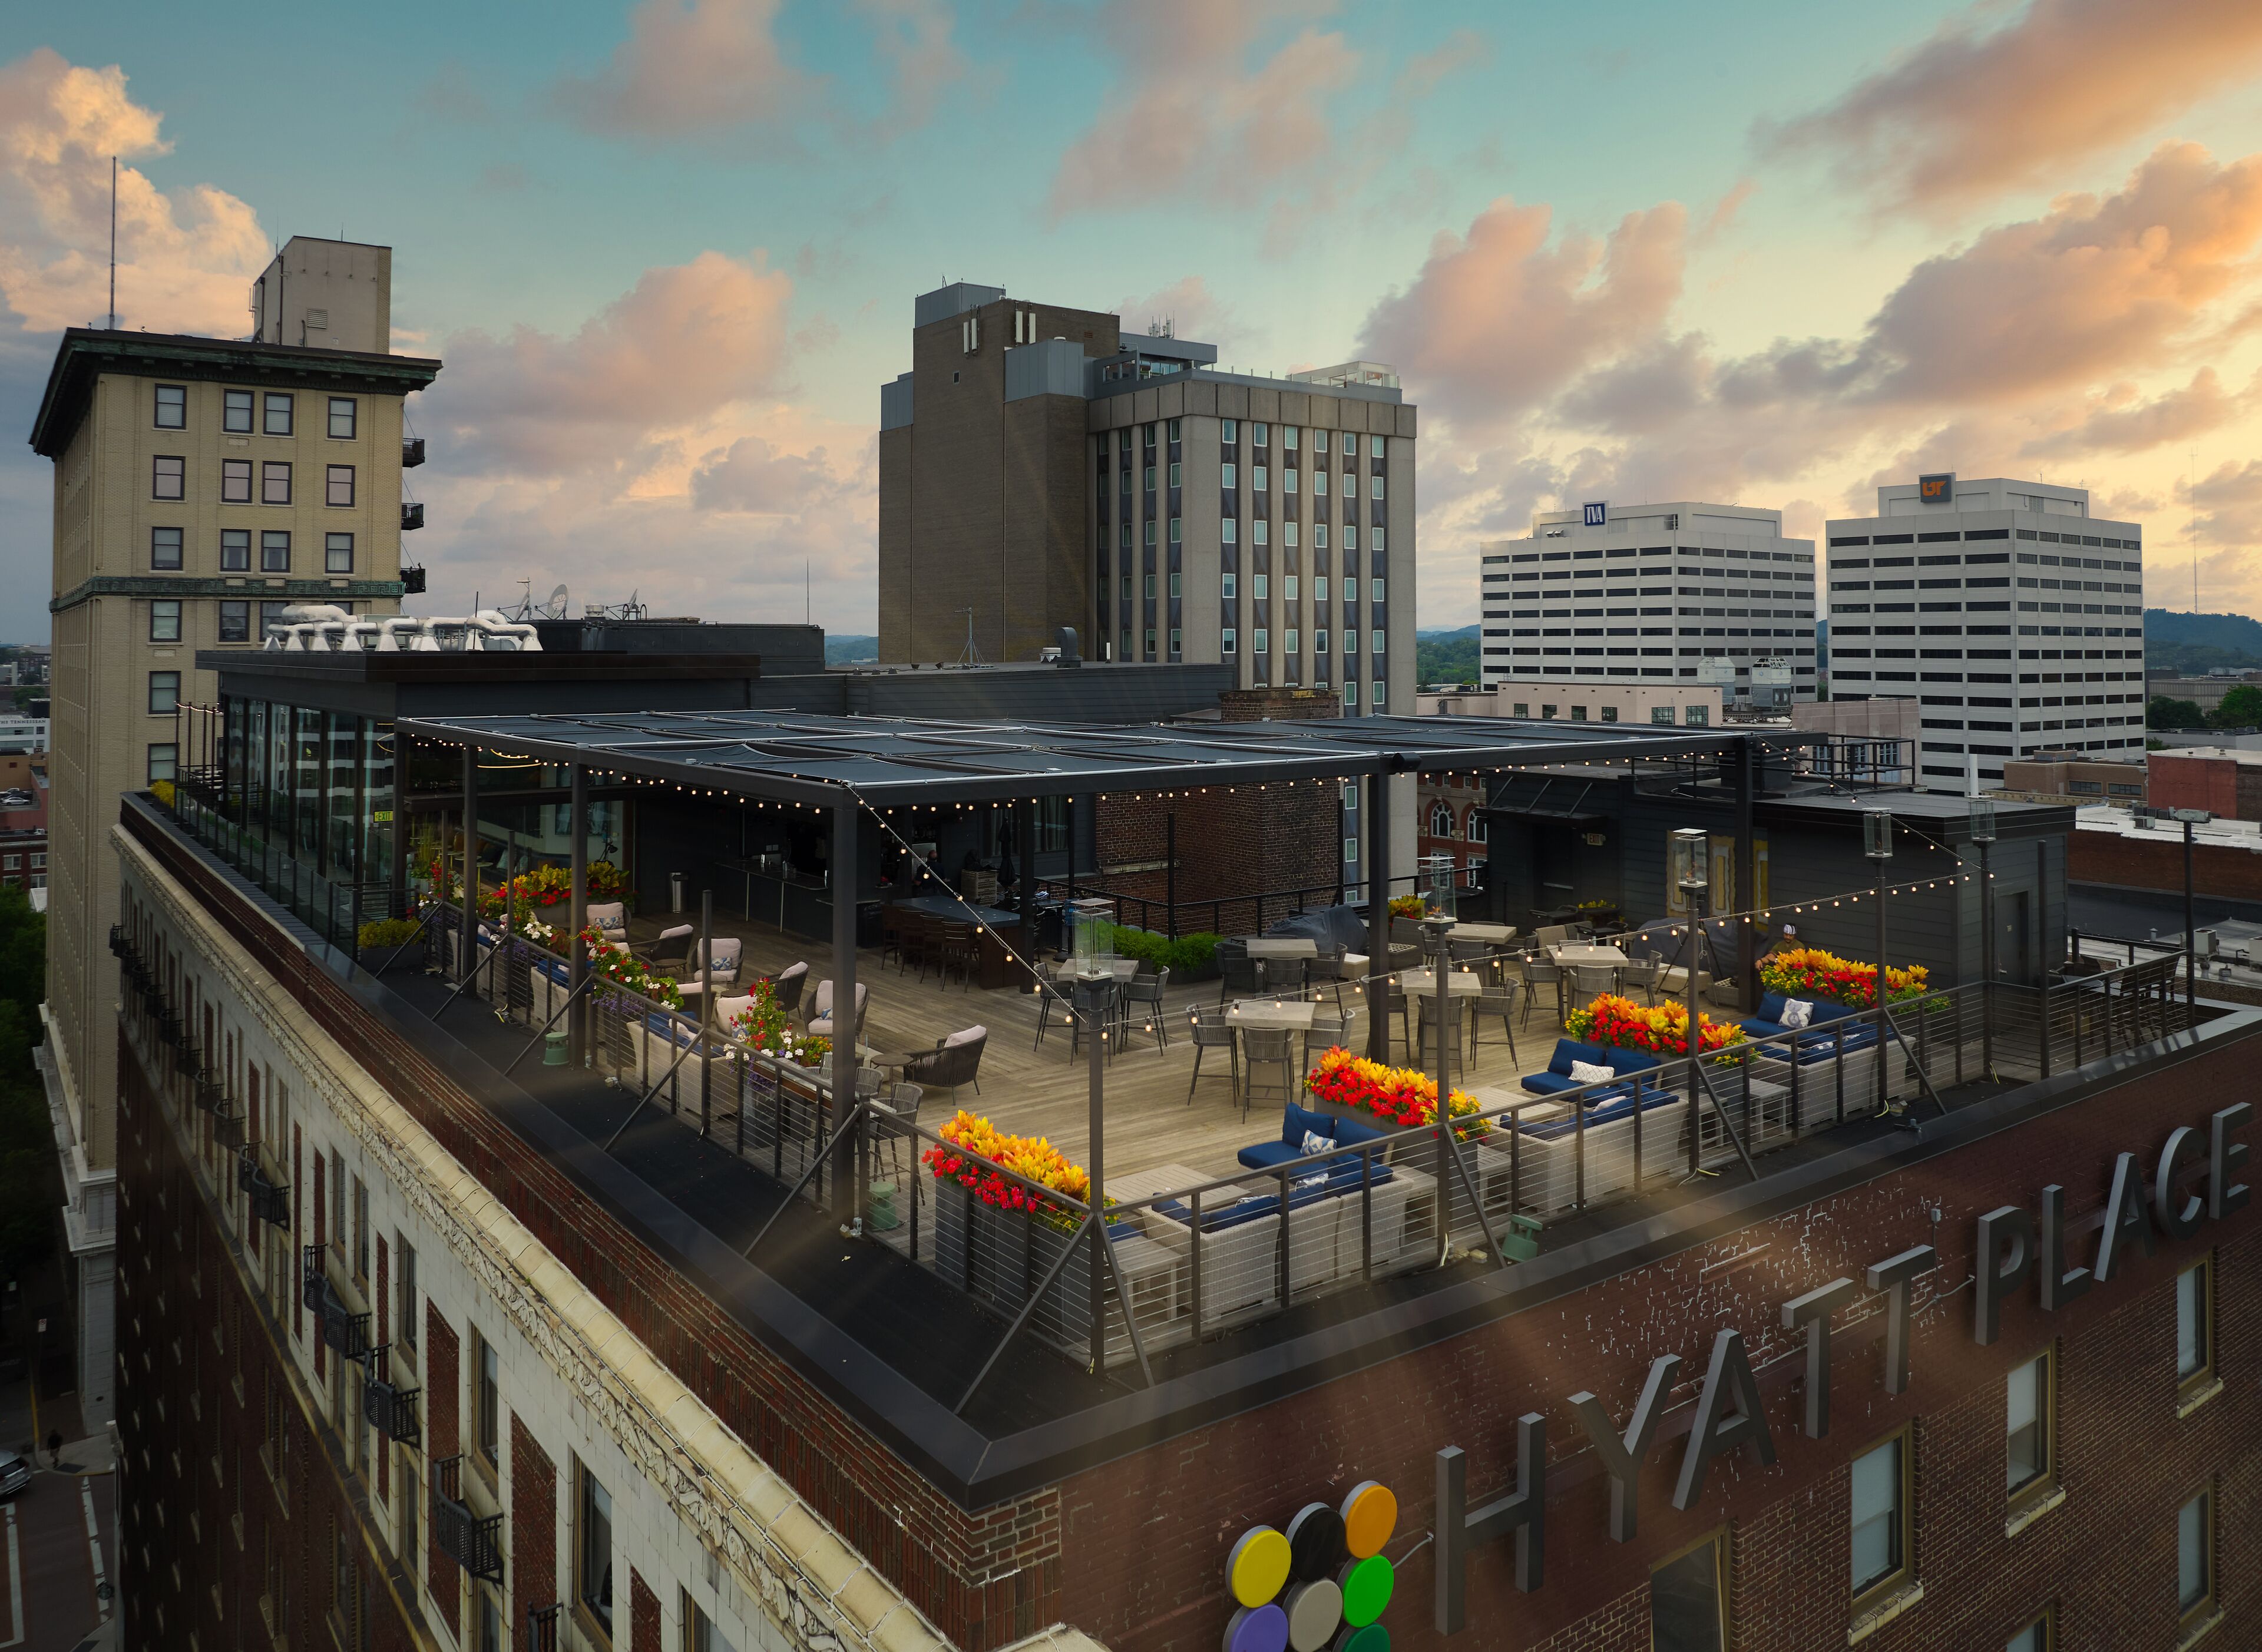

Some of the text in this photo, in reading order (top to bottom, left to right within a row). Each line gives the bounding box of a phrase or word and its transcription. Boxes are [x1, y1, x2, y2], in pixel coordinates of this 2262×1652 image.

[1586, 506, 1602, 523] TVA
[378, 812, 391, 820] EXIT
[1589, 834, 1599, 843] EXIT
[1436, 1101, 2253, 1636] HYATT PLACE
